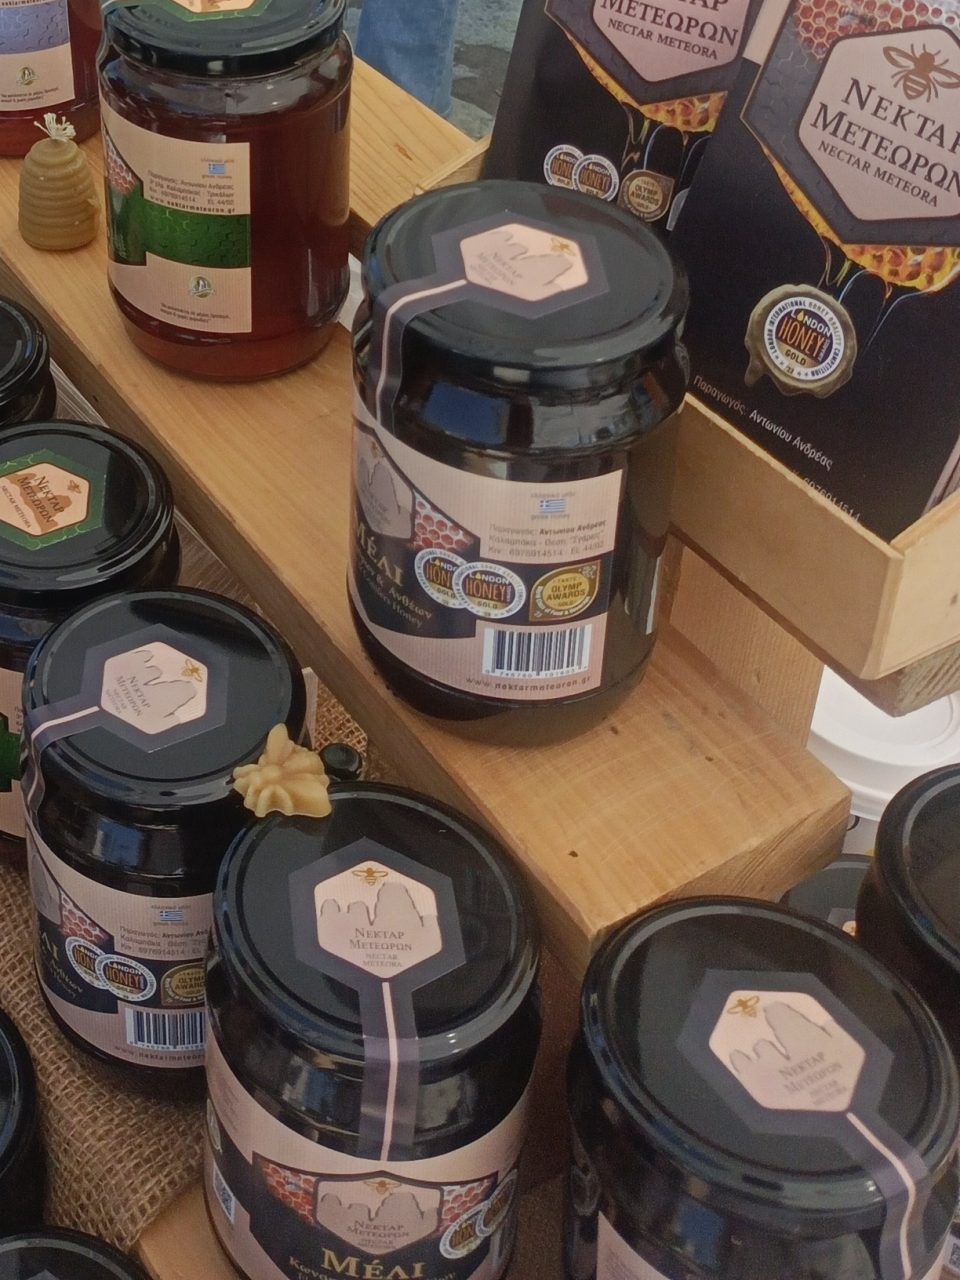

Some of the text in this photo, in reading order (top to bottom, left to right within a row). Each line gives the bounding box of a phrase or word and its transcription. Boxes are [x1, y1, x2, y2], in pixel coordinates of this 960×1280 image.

[607, 18, 718, 60] NECTAR METEORA
[818, 140, 938, 208] NECTAR METEORA
[778, 316, 825, 357] HONEY
[784, 349, 806, 366] GOLD
[749, 409, 792, 442] Αντωνίου
[792, 436, 833, 471] Ανδρέας
[426, 565, 453, 590] HON
[551, 581, 583, 592] OLYMP
[465, 578, 507, 602] HONEY
[546, 588, 586, 602] AWARDS
[355, 927, 405, 939] ΝΕΚΤΑΡ
